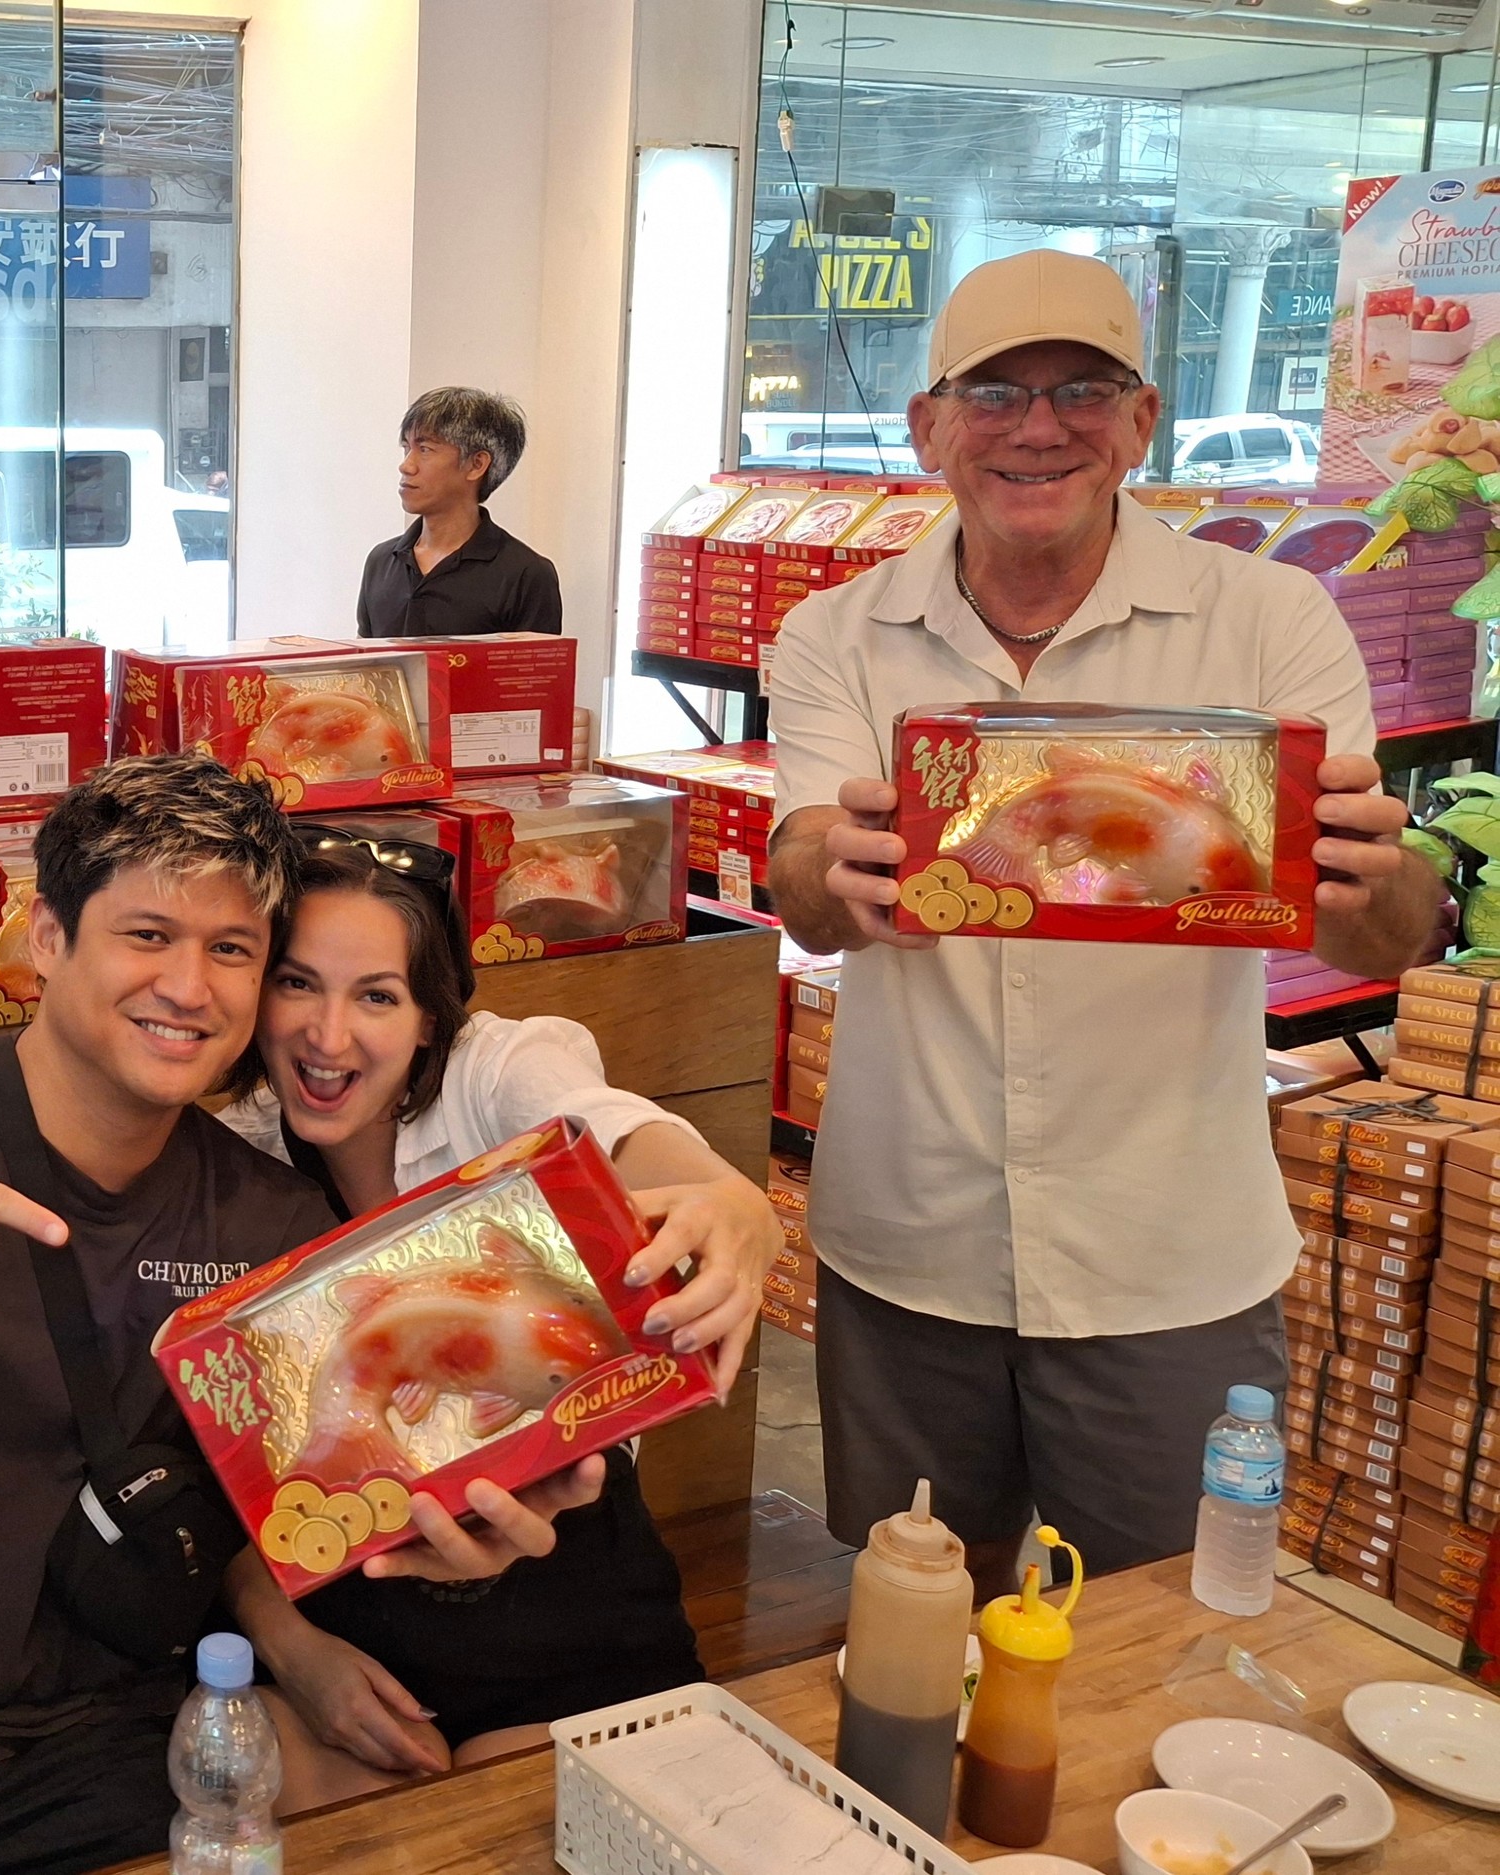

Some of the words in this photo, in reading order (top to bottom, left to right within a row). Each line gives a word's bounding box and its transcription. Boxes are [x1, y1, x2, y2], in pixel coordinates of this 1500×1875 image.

[1347, 180, 1386, 221] New!
[1398, 206, 1500, 245] Strawb
[1398, 236, 1500, 269] CHEESEC
[815, 254, 913, 309] PIZZA
[1397, 266, 1455, 281] PREMIUM
[1437, 982, 1481, 998] SPECIA
[1435, 1006, 1478, 1022] SPECIA
[1432, 1030, 1473, 1046] SPECI
[1425, 1071, 1466, 1088] SPECIA
